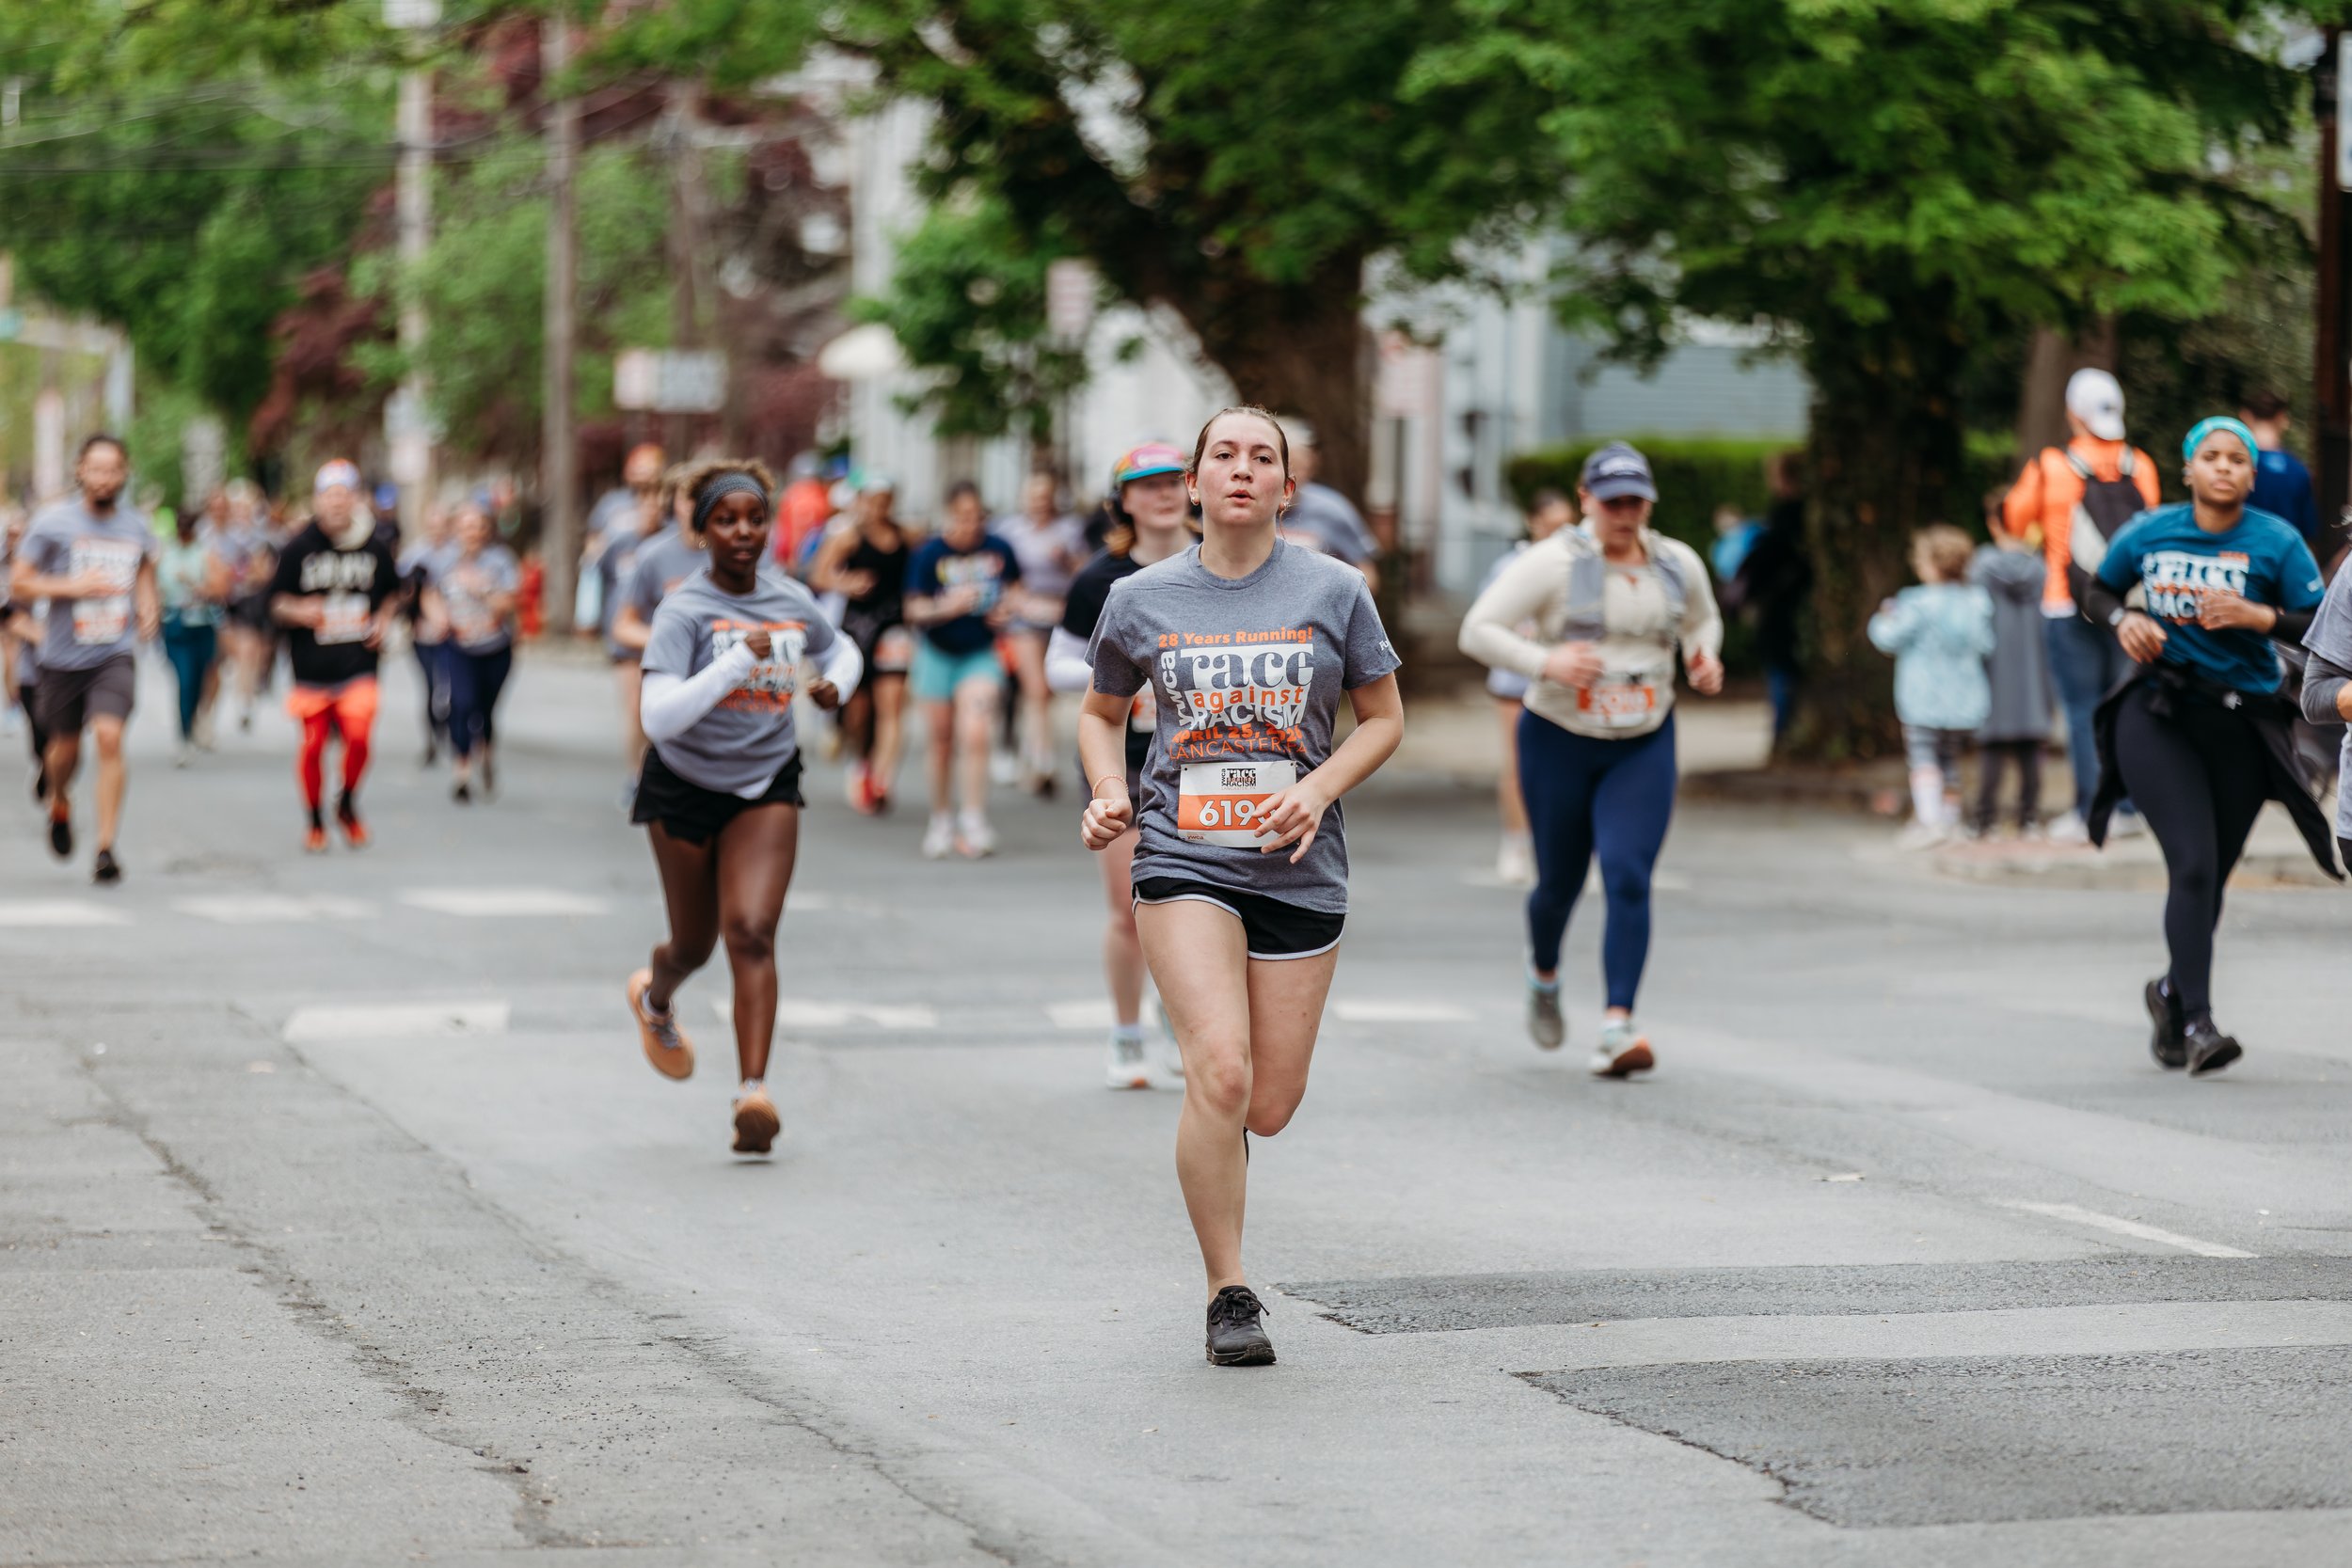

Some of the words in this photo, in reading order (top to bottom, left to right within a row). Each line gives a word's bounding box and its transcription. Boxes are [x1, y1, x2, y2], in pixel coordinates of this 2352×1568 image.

[1158, 632, 1179, 648] 28
[1183, 631, 1231, 646] Years
[1235, 626, 1313, 644] Running!
[1176, 650, 1314, 690] race
[1161, 650, 1194, 726] ywca
[1192, 685, 1304, 714] against
[1188, 705, 1308, 730] RACISM
[1227, 722, 1261, 739] 25,
